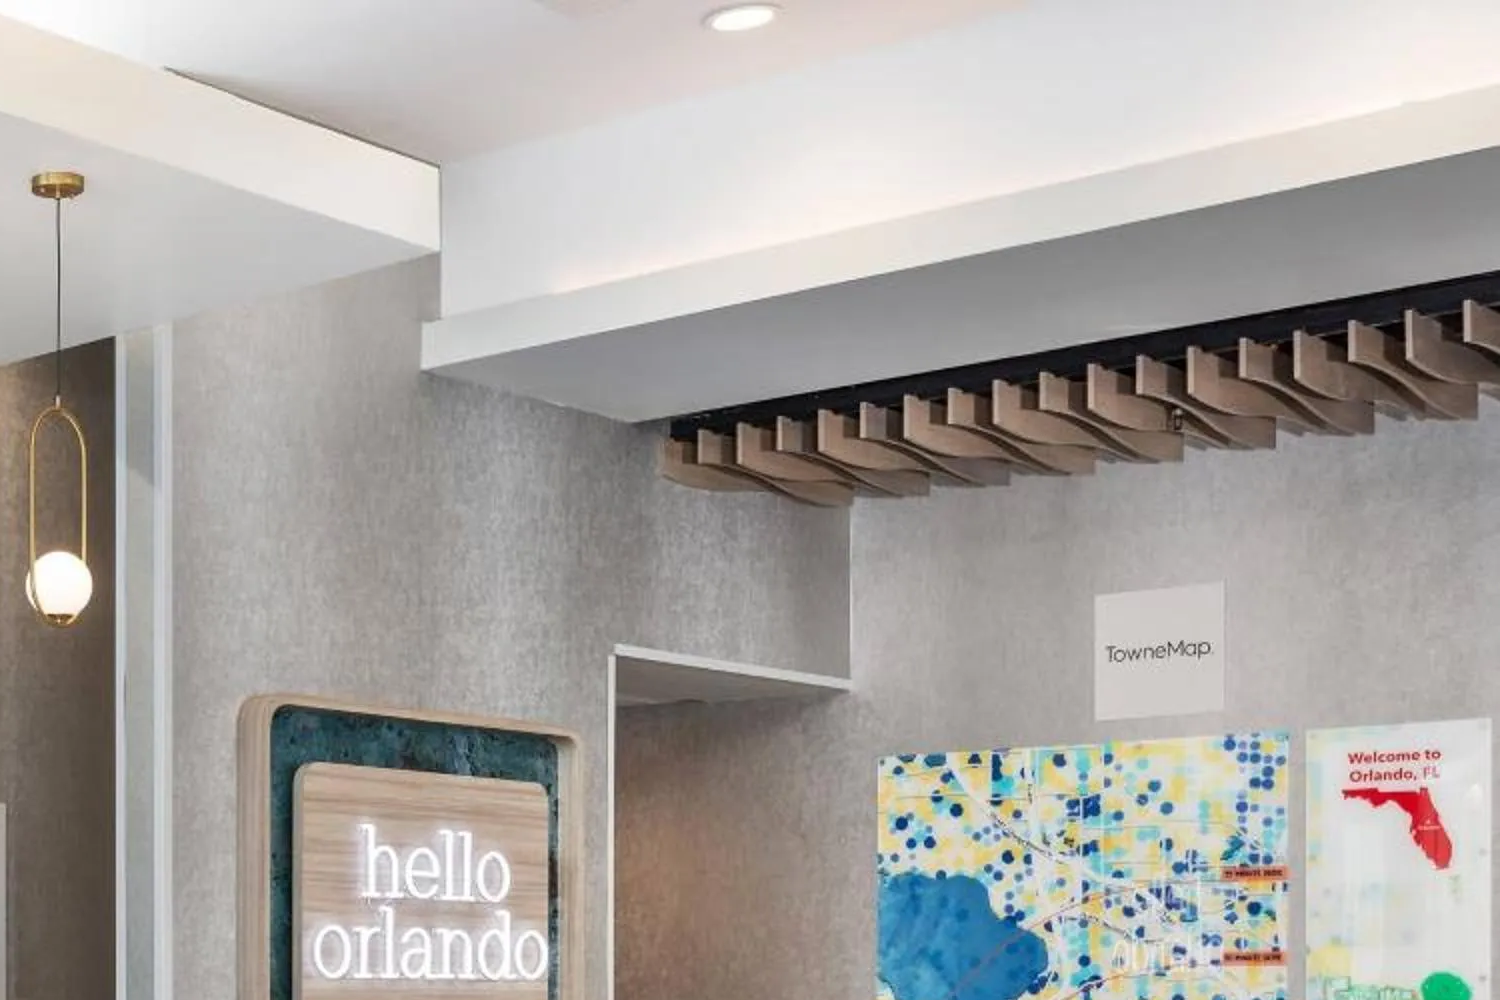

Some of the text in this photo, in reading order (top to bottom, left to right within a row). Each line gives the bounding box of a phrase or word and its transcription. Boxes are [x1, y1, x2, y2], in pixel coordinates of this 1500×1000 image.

[1105, 640, 1212, 662] TowneMap
[1347, 749, 1442, 765] Welcome to
[1348, 765, 1441, 783] Orlando, FL
[357, 822, 512, 903] hello
[312, 905, 549, 981] orlando
